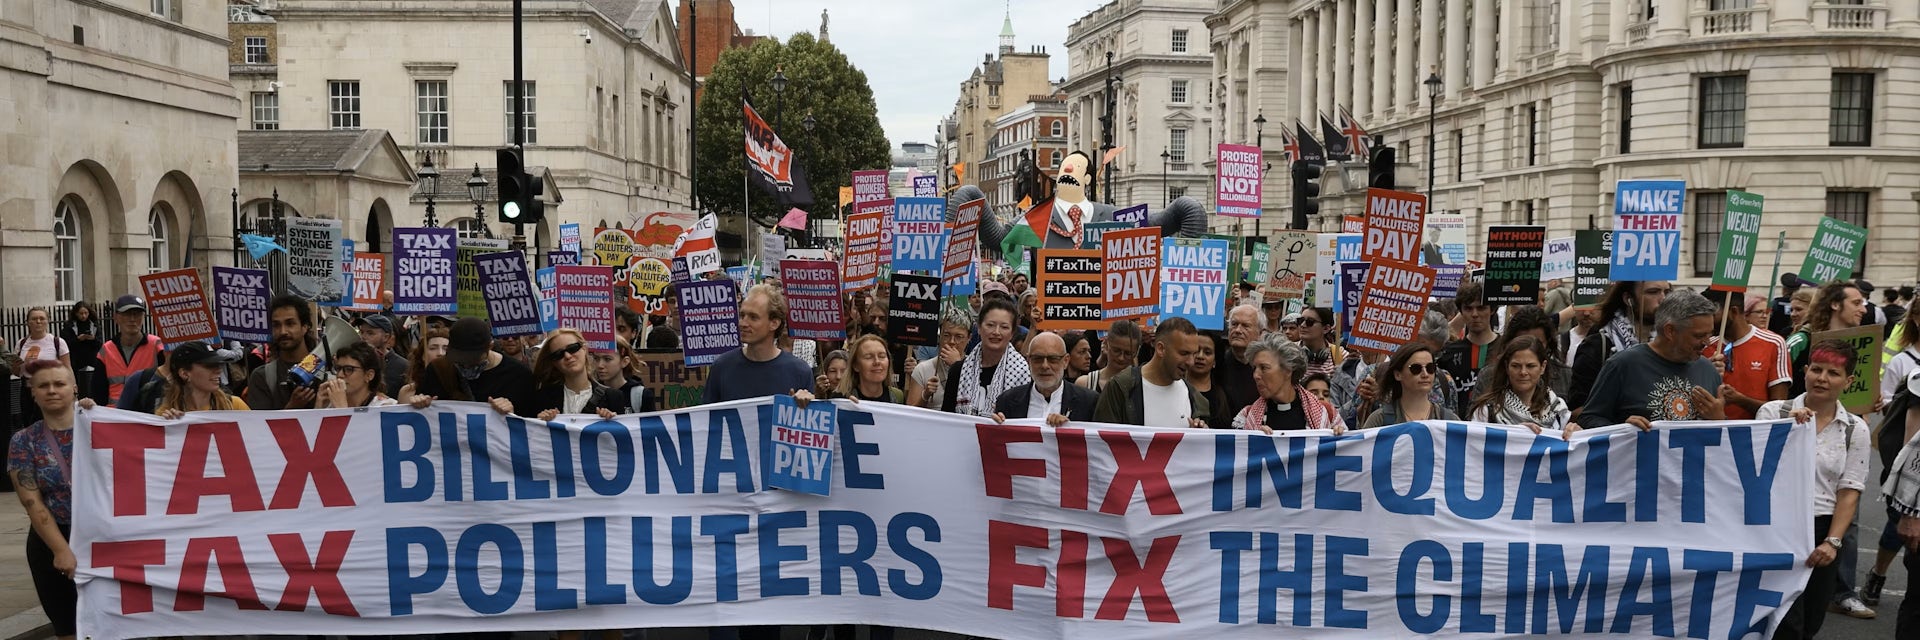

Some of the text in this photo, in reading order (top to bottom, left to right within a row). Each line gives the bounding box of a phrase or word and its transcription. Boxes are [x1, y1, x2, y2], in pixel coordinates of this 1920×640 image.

[1221, 150, 1258, 163] PROTECT
[1221, 162, 1258, 178] WORKERS
[855, 174, 885, 183] PROTECT
[1220, 177, 1258, 195] NOT
[855, 183, 885, 195] WORKERS
[1220, 193, 1258, 202] BILLIONAIRES
[1622, 189, 1680, 212] MAKE
[1751, 201, 1762, 209] Party
[898, 204, 942, 220] MAKE
[957, 205, 981, 225] FUND:
[1116, 209, 1146, 223] TAX
[1371, 197, 1421, 221] MAKE
[850, 217, 881, 237] FUND:
[898, 222, 940, 233] THEM
[1369, 216, 1419, 232] POLLUTERS
[1620, 215, 1676, 230] THEM
[1727, 211, 1760, 233] WEALTH
[289, 228, 330, 240] SYSTEM
[561, 227, 578, 236] MAKE
[604, 234, 624, 243] MAKE
[1490, 231, 1544, 240] WITHOUT
[1833, 223, 1864, 239] Green Party
[289, 238, 333, 250] CHANGE
[399, 234, 451, 249] TAX
[562, 236, 579, 244] THEM
[896, 235, 941, 259] PAY
[1107, 235, 1156, 259] MAKE
[1366, 228, 1418, 261] PAY
[1731, 234, 1749, 256] TAX
[1820, 232, 1856, 254] MAKE
[290, 247, 308, 257] NOT
[407, 249, 442, 257] THE
[595, 244, 633, 253] POLLUTERS
[1254, 250, 1269, 262] WEA
[1616, 232, 1676, 266] PAY
[290, 256, 334, 269] CLIMATE
[550, 254, 575, 263] TAX
[606, 253, 620, 262] PAY
[691, 252, 716, 269] RICH
[848, 255, 872, 266] HEALTH
[1107, 257, 1157, 271] POLLUTERS
[1168, 246, 1222, 267] MAKE
[1491, 260, 1536, 268] CLIMATE
[1810, 247, 1854, 269] POLLUTERS
[290, 266, 333, 278] CHANGE
[354, 258, 382, 271] AKE
[399, 257, 452, 275] SUPER
[457, 263, 477, 277] NOT
[480, 257, 522, 274] TAX
[641, 263, 661, 272] MAKE
[1046, 259, 1101, 271] #TaxThe
[1577, 266, 1595, 274] the
[1723, 257, 1747, 280] NOW
[218, 272, 264, 288] TAX
[489, 273, 517, 282] THE
[632, 272, 670, 282] POLLUTERS
[784, 268, 836, 280] PROTECT:
[1168, 268, 1221, 283] THEM
[1372, 265, 1429, 293] FUND:
[1486, 270, 1539, 279] JUSTICE
[1577, 276, 1609, 284] billion
[1812, 263, 1840, 282] PAY
[145, 275, 198, 297] FUND:
[399, 275, 452, 298] RICH
[560, 274, 609, 287] PROTECT:
[643, 281, 656, 290] PAY
[1106, 269, 1156, 302] PAY
[226, 286, 256, 295] THE
[354, 279, 381, 299] AY
[486, 280, 528, 299] SUPER
[681, 285, 733, 306] FUND:
[894, 281, 938, 301] TAX
[1046, 282, 1101, 295] #TaxThe
[219, 292, 266, 310] SUPER
[399, 303, 424, 311] MAKE
[436, 303, 451, 311] PAY
[789, 298, 838, 310] NATURE &
[1165, 284, 1222, 315] PAY
[490, 297, 535, 322] RICH
[561, 306, 611, 318] NATURE &
[790, 310, 841, 324] CLIMATE
[889, 309, 938, 321] SUPER-RICH
[1046, 305, 1101, 317] #TaxThe
[1107, 307, 1129, 318] MAKE
[1139, 305, 1153, 315] PAY
[1362, 306, 1416, 327] HEALTH &
[158, 310, 208, 327] HEALTH &
[221, 307, 268, 329] RICH
[163, 321, 212, 339] OUR FUTURES
[562, 319, 611, 333] CLIMATE
[685, 322, 738, 336] OUR NHS &
[1359, 319, 1413, 341] OUR FUTURES
[687, 334, 739, 349] OUR SCHOOLS
[664, 384, 705, 409] TAX
[777, 404, 831, 432] MAKE
[777, 427, 829, 448] THEM
[90, 404, 1792, 526] TAX BILLIONAIE FIX INEQUALITY
[774, 444, 829, 481] PAY
[90, 510, 1793, 640] TAX POLLUTERS FIX THE CLIMATE
